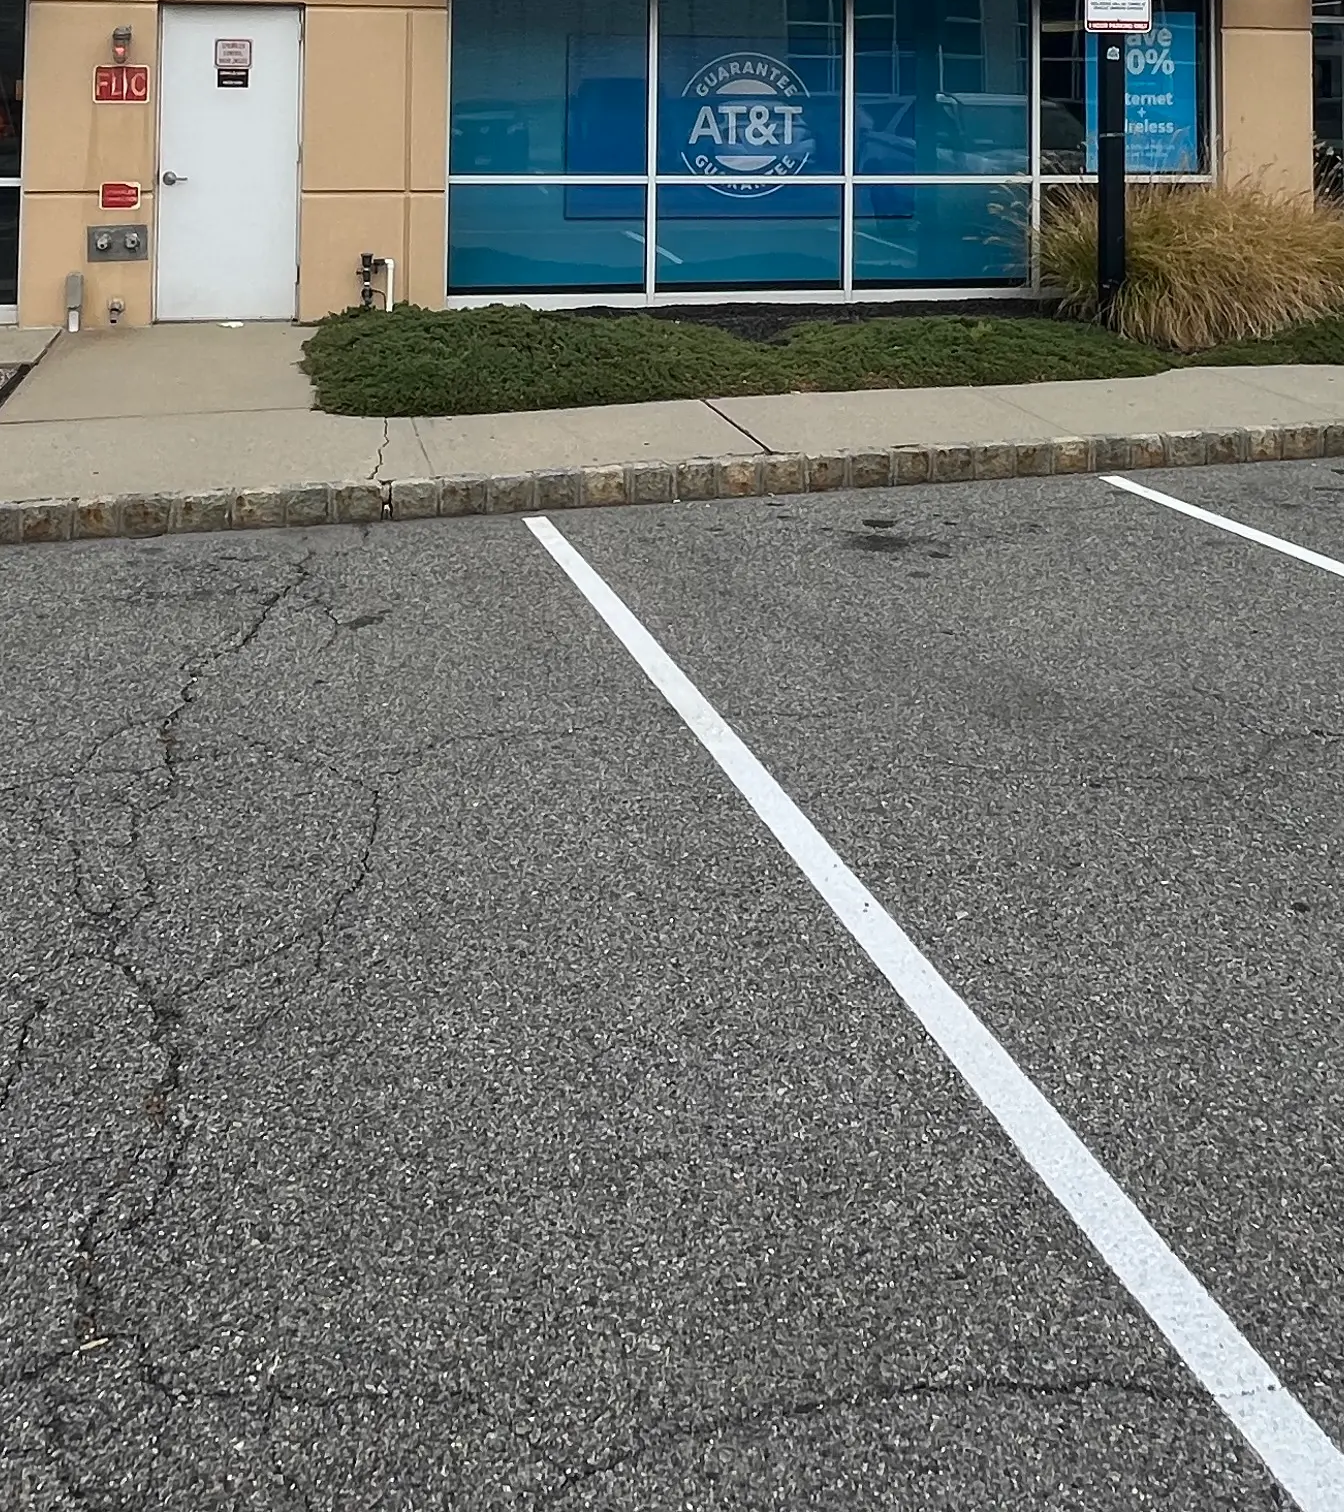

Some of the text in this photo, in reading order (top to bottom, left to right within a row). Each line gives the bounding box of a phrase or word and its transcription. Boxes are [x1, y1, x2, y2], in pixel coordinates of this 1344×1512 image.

[1126, 28, 1172, 47] ave
[1126, 48, 1175, 75] 0%
[696, 61, 799, 97] GUARANTEE
[1125, 92, 1173, 105] ternet
[688, 105, 803, 146] AT&T
